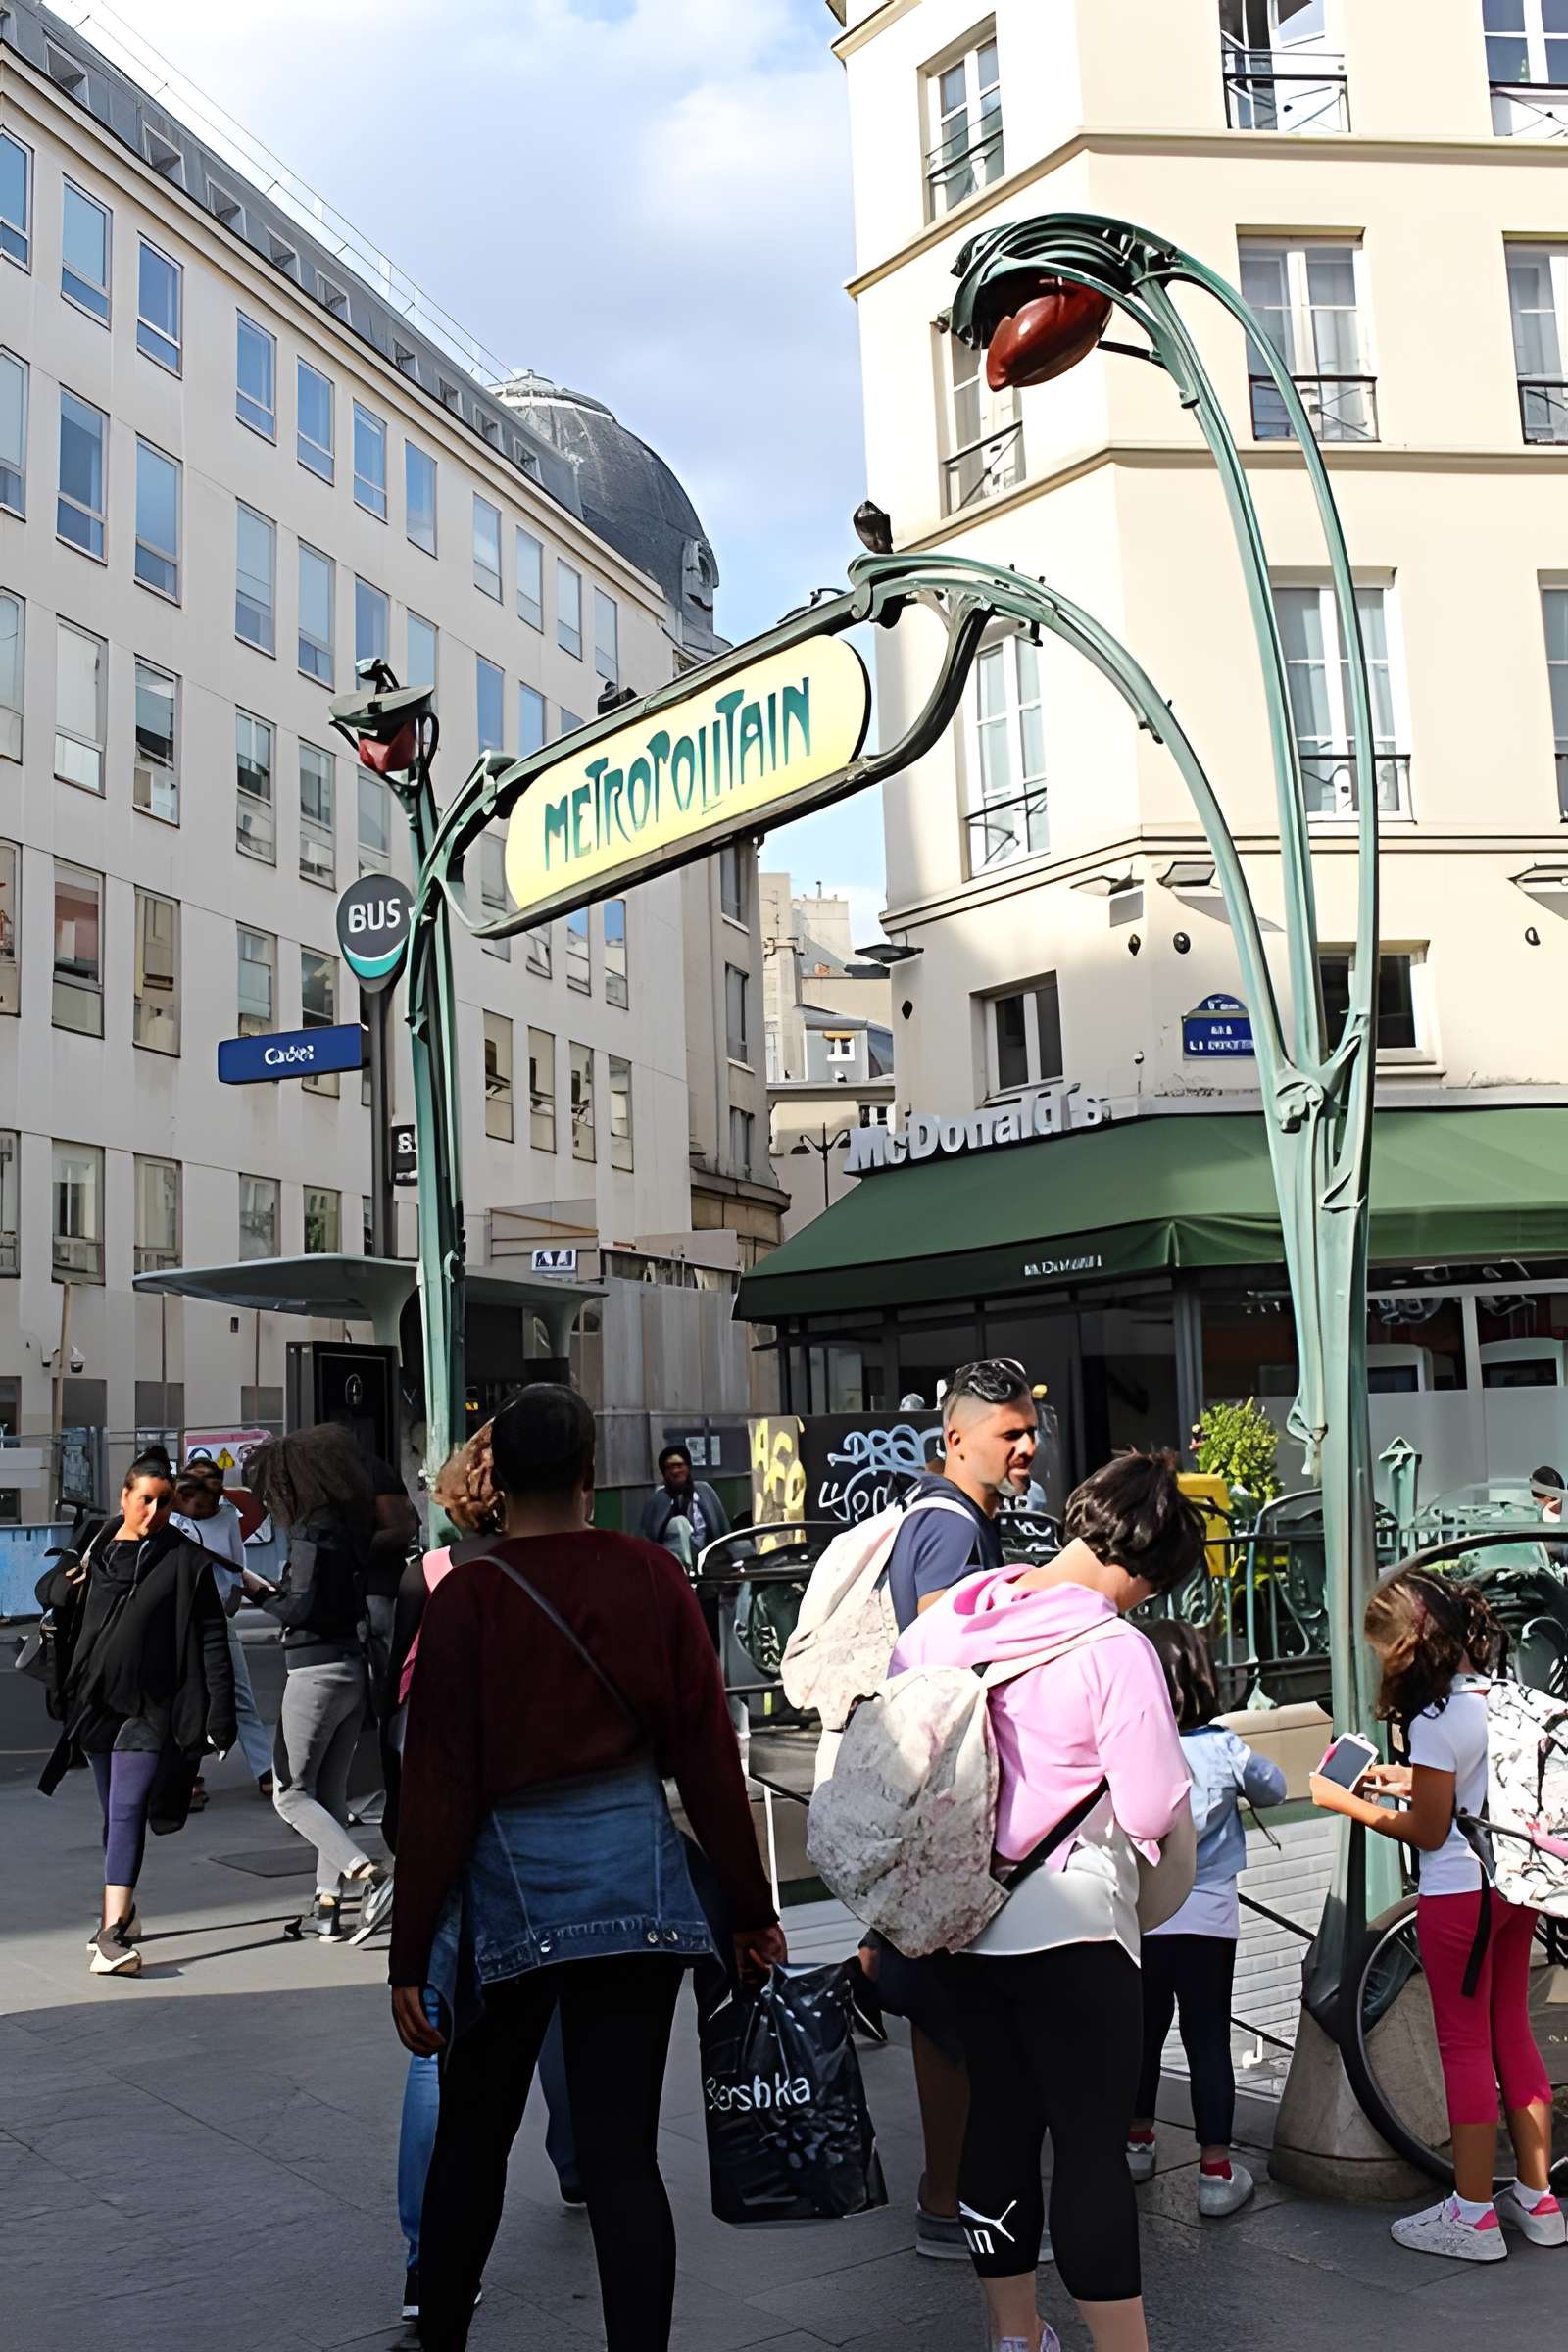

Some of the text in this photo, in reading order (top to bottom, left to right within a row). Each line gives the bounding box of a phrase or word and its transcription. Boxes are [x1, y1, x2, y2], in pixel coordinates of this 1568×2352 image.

[543, 675, 811, 872] METROPOLITAIN
[348, 898, 401, 933] BUS
[845, 1082, 1104, 1173] McDonald's
